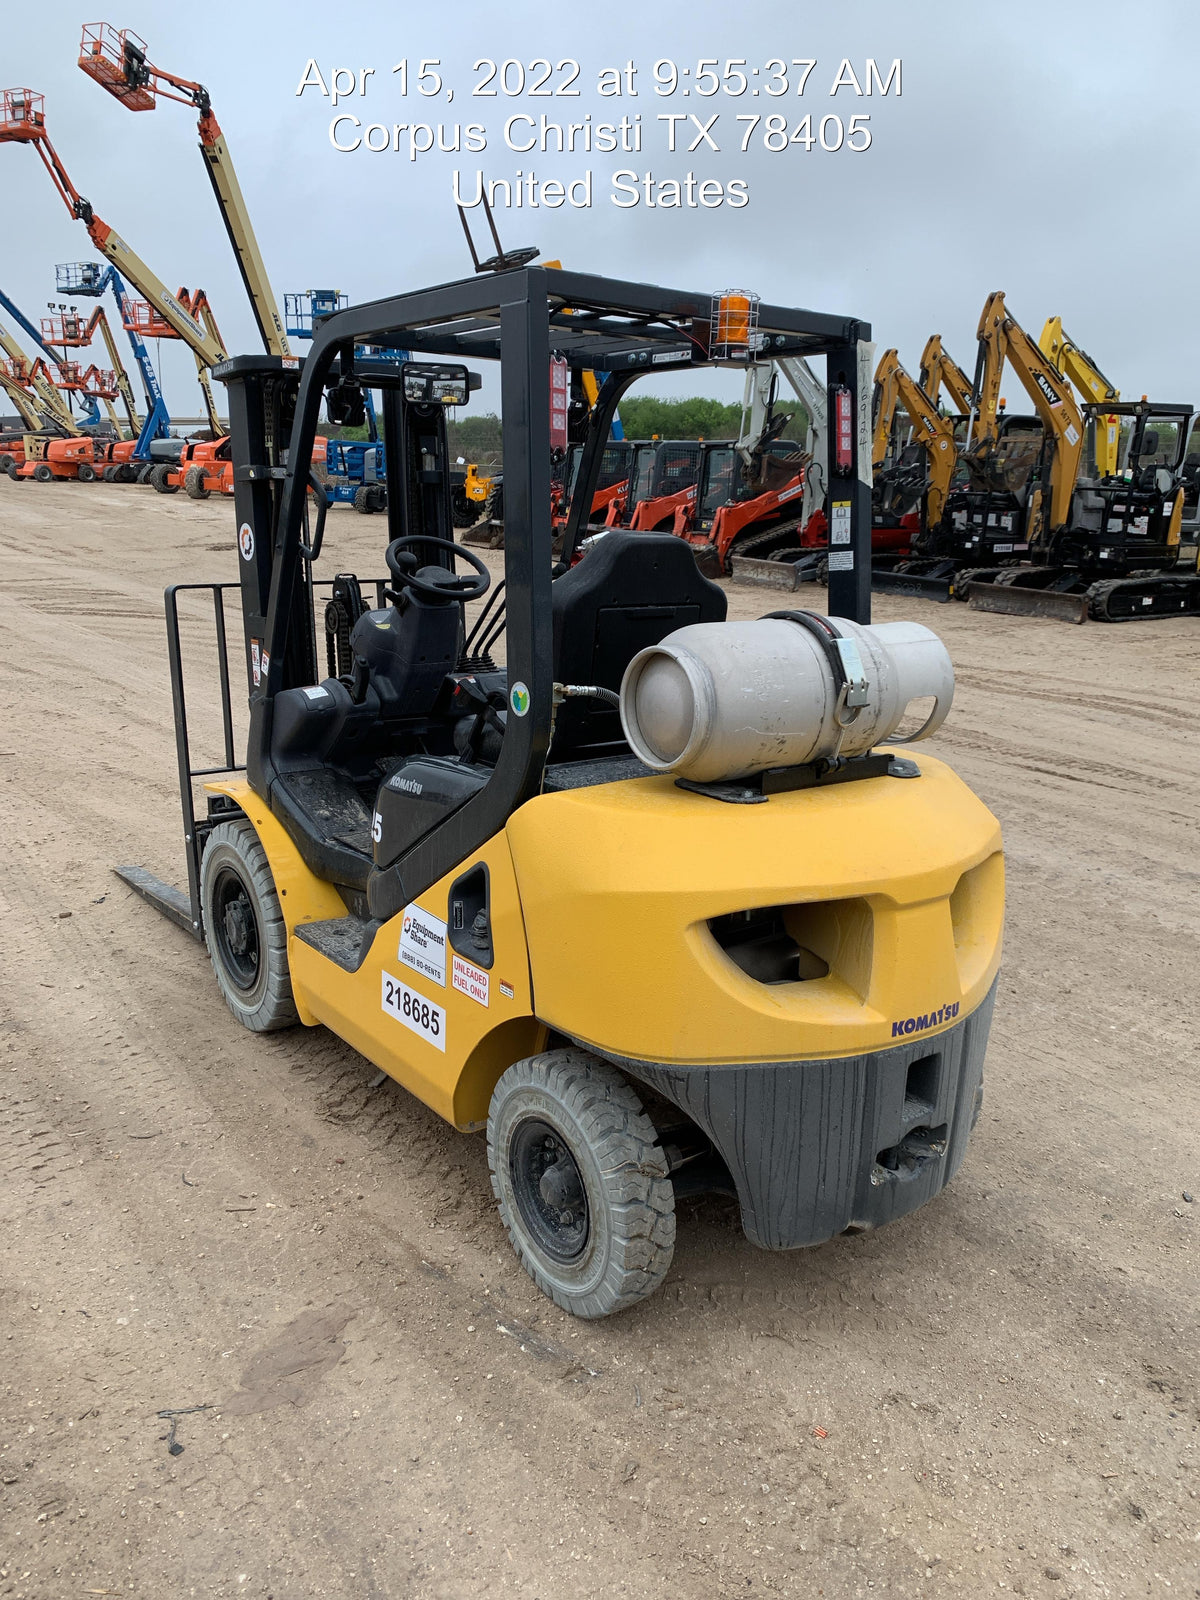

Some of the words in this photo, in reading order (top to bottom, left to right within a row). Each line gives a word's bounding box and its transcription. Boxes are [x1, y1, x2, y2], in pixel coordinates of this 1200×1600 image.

[271, 312, 281, 332] JLG
[1037, 376, 1057, 403] SANY
[390, 775, 423, 795] KOMATSU
[410, 929, 427, 949] Share
[412, 917, 445, 946] Equipment
[402, 950, 416, 965] (888)
[454, 960, 487, 987] UNLEADED
[454, 974, 469, 992] FUEL
[470, 984, 487, 1001] ONLY
[385, 980, 440, 1036] 218685
[891, 1001, 960, 1038] KOMATSU
